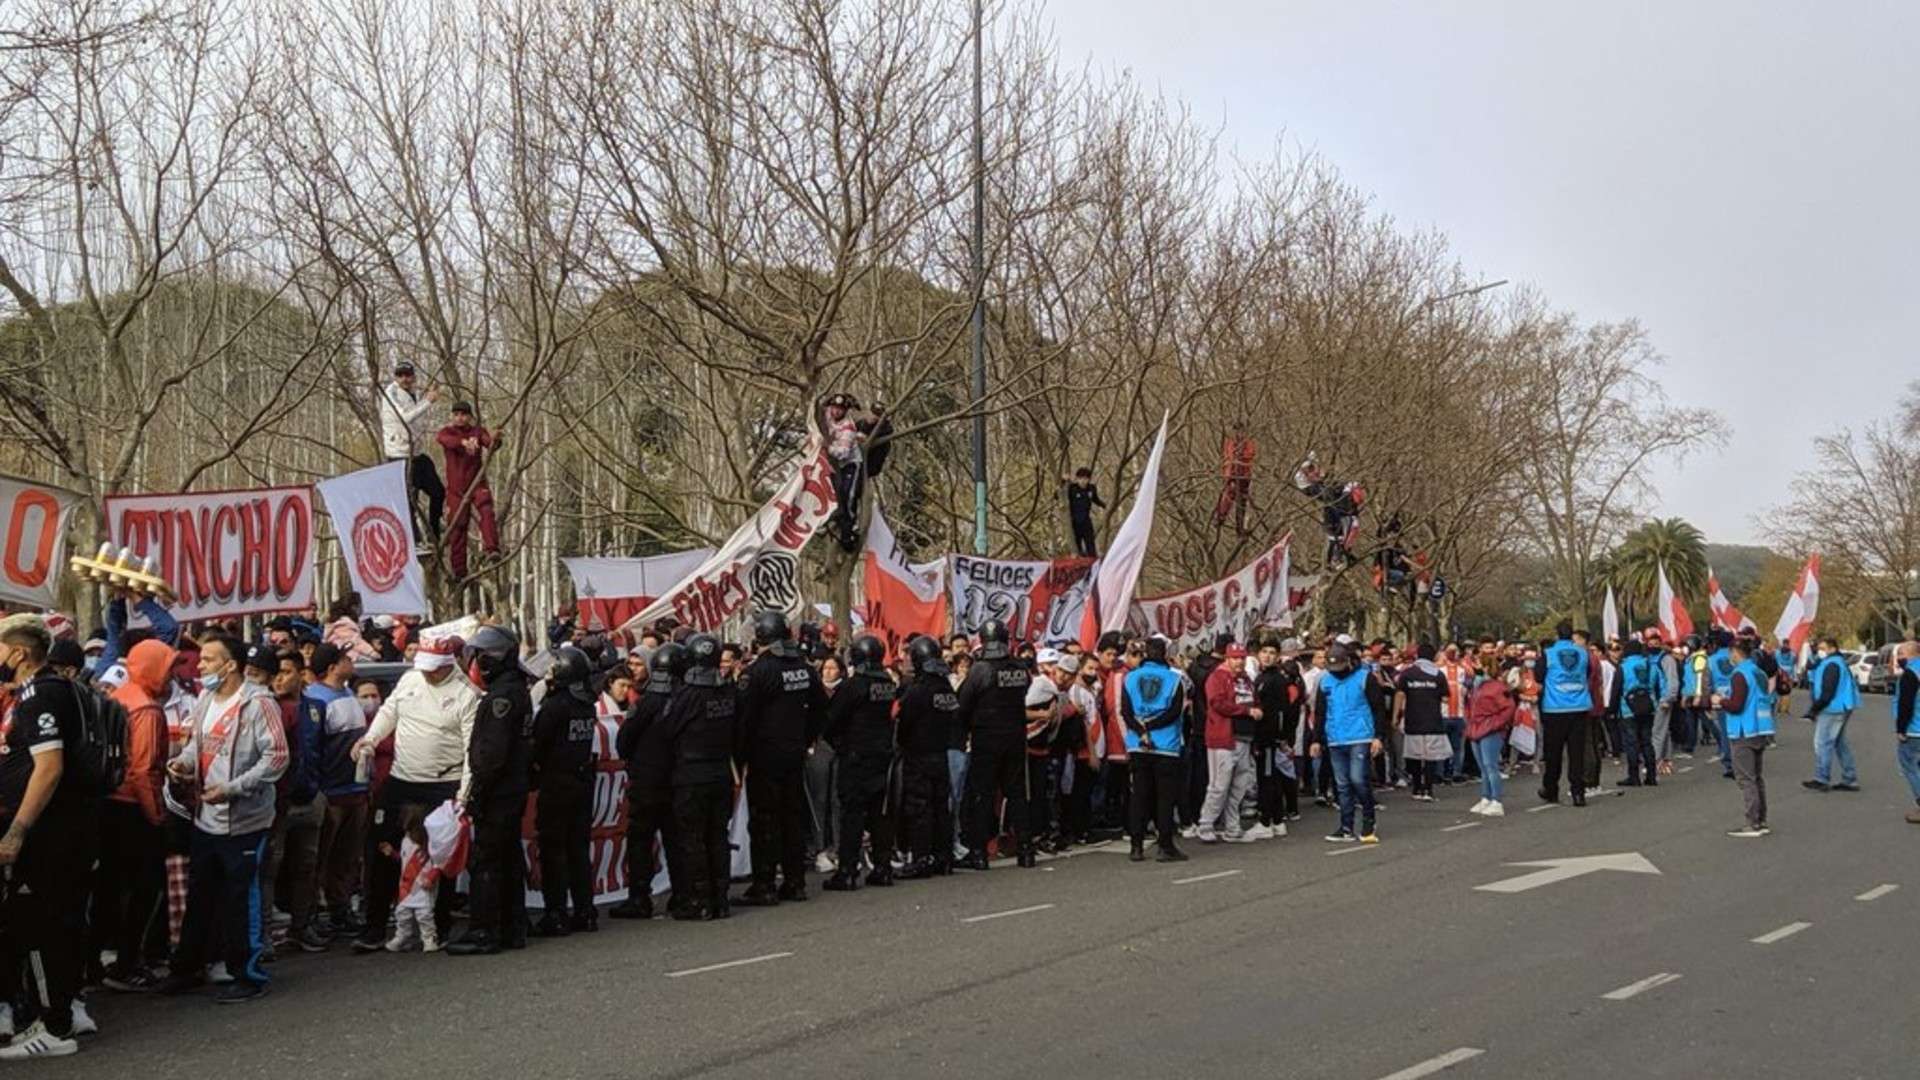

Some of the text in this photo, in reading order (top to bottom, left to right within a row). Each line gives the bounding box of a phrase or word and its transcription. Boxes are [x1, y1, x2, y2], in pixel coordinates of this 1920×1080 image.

[122, 494, 308, 607] TINCHO
[955, 556, 1034, 588] FELICES
[998, 669, 1026, 681] POLICIA
